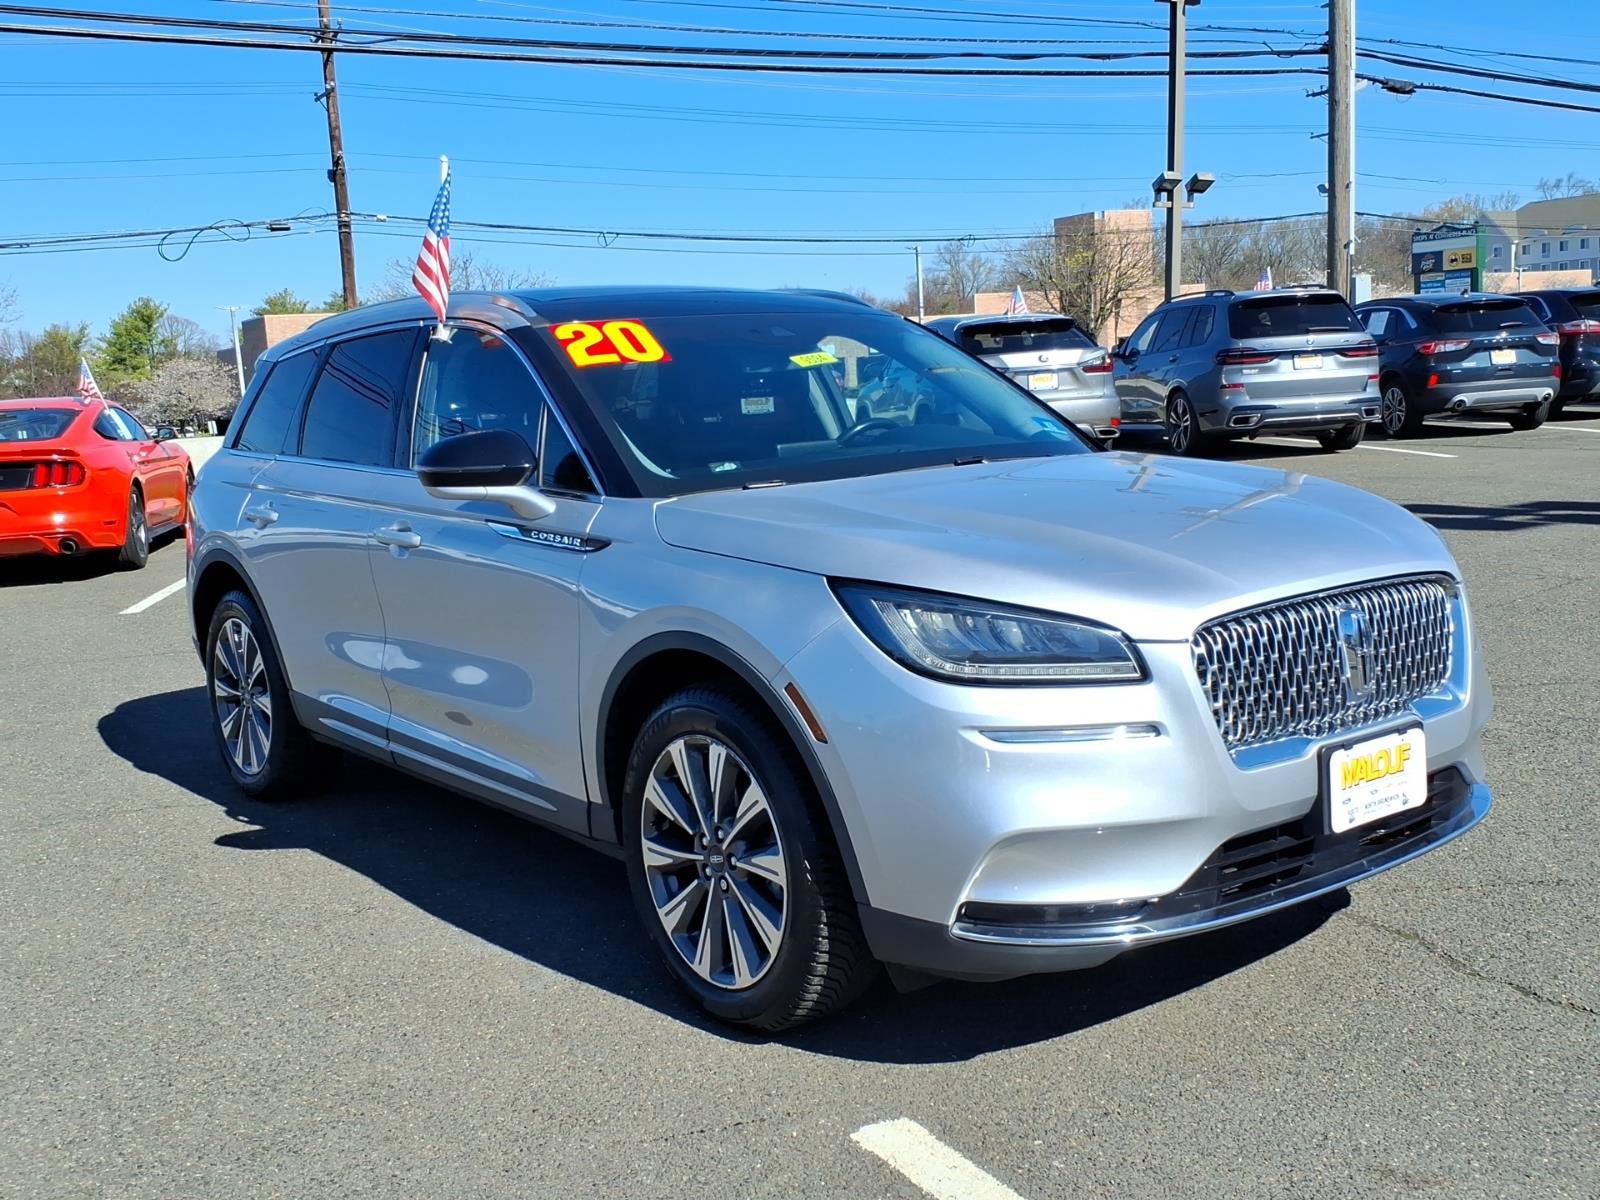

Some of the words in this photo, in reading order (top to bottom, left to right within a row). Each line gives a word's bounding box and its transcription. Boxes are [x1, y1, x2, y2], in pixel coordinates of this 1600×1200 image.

[554, 321, 665, 368] 20
[531, 531, 581, 546] CORSAIR
[1340, 743, 1411, 791] MALOUF
